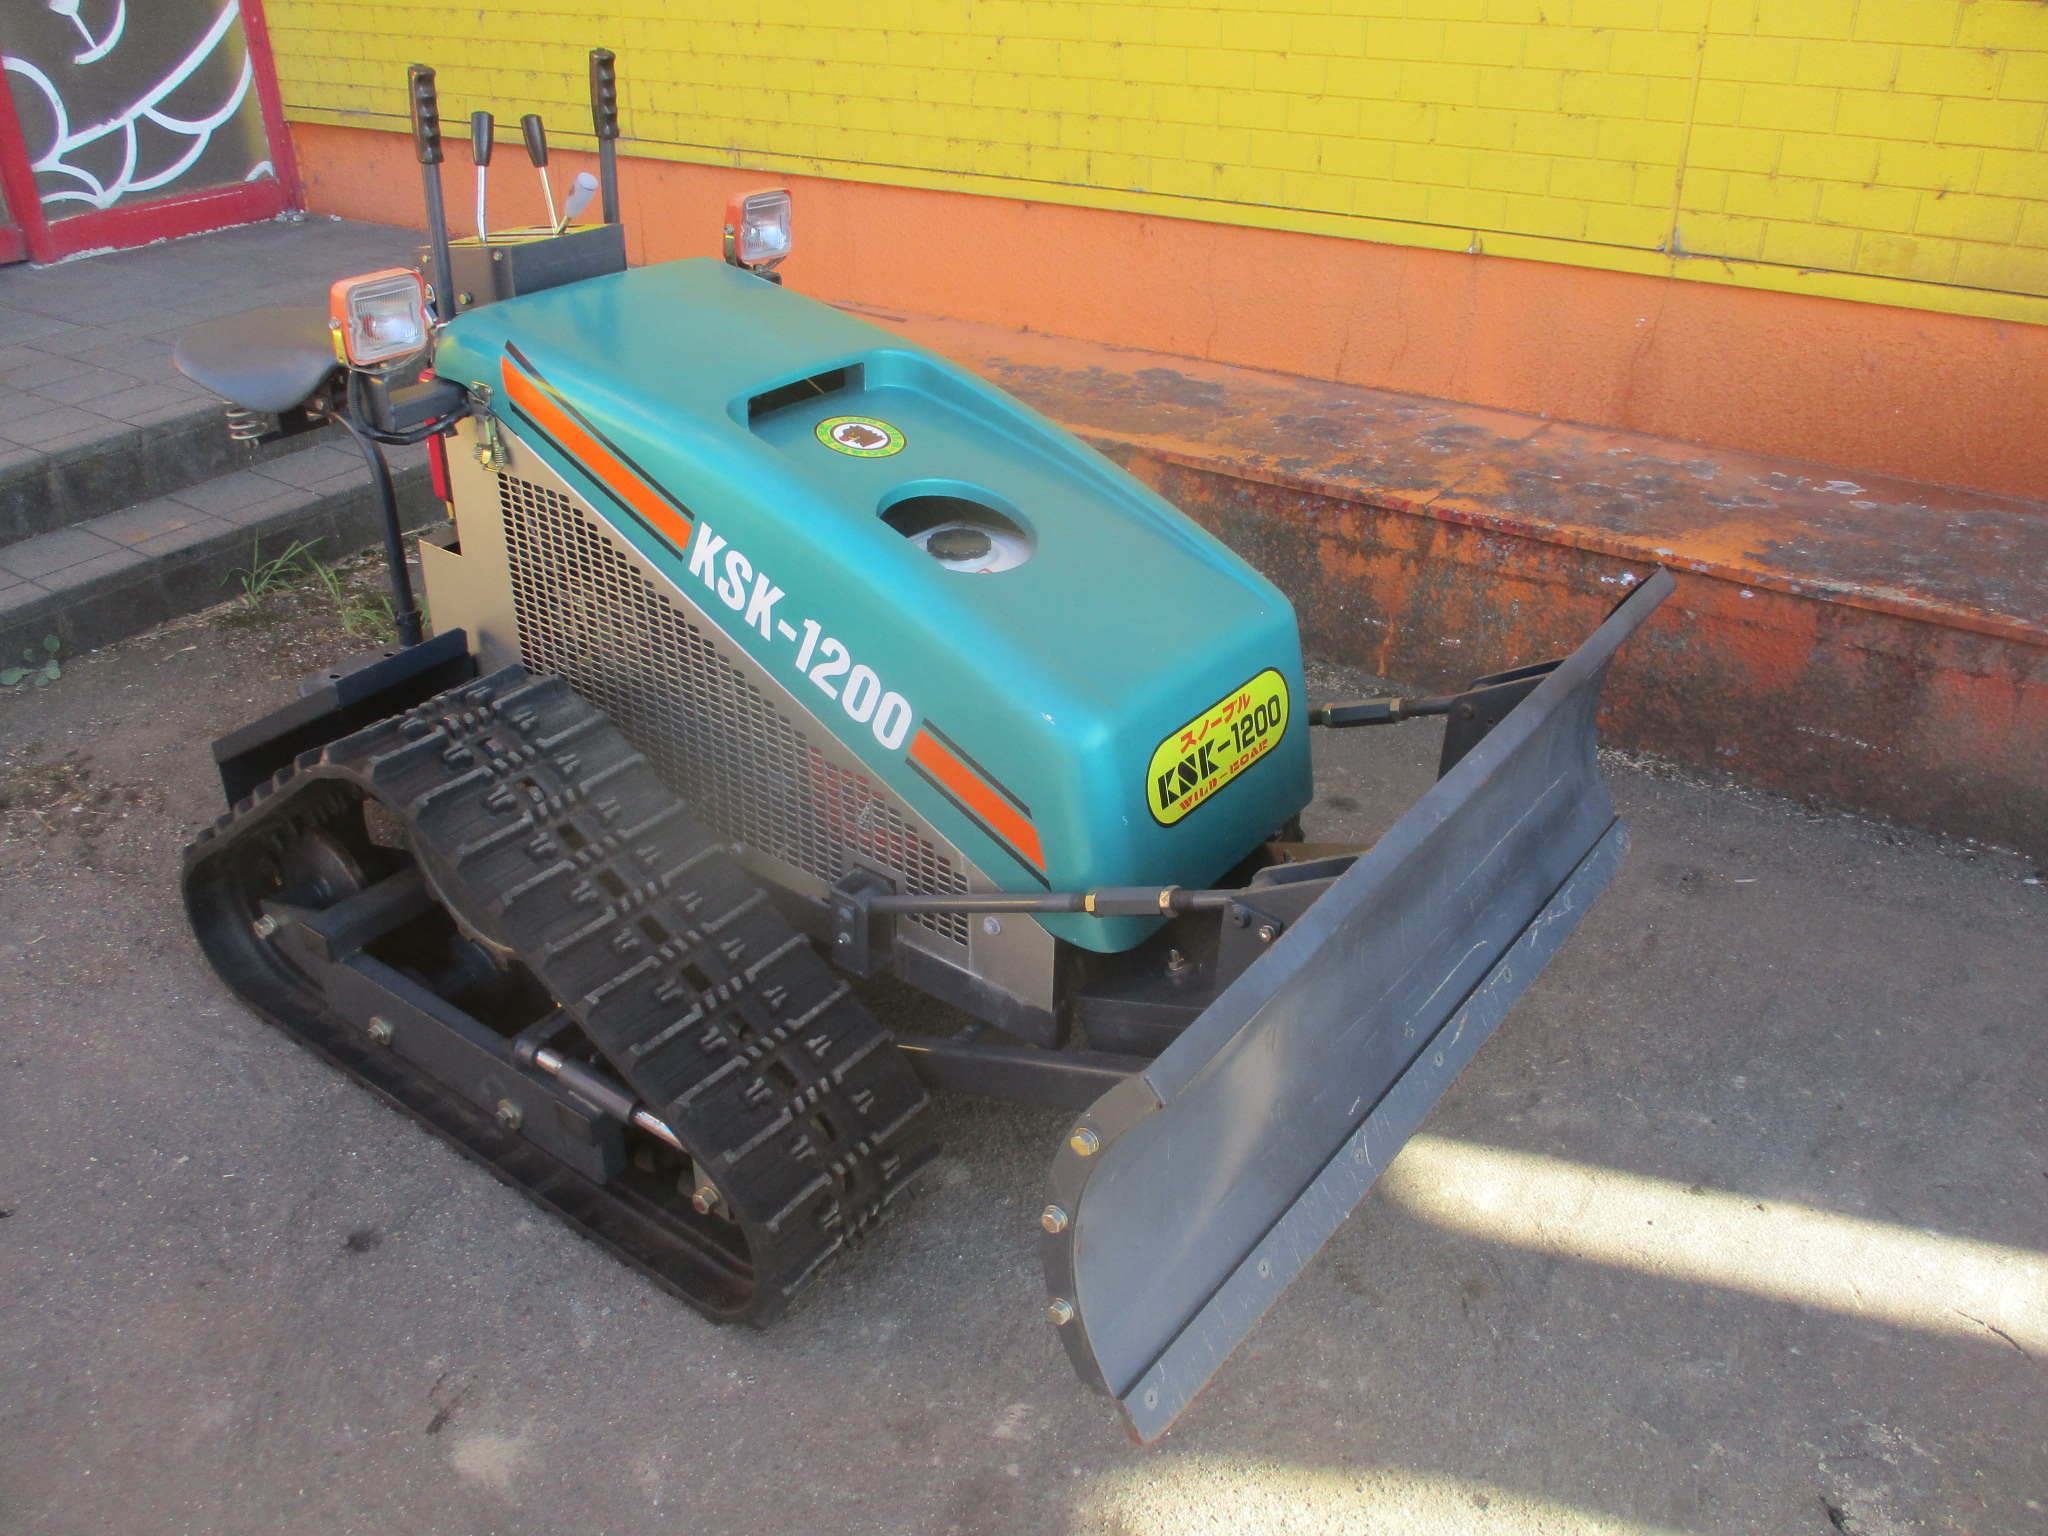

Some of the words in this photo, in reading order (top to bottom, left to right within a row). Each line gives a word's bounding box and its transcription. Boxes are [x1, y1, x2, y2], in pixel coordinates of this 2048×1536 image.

[689, 521, 913, 750] KSK-1200
[1158, 695, 1281, 811] KSK-1200
[1180, 693, 1251, 754] スノーブル
